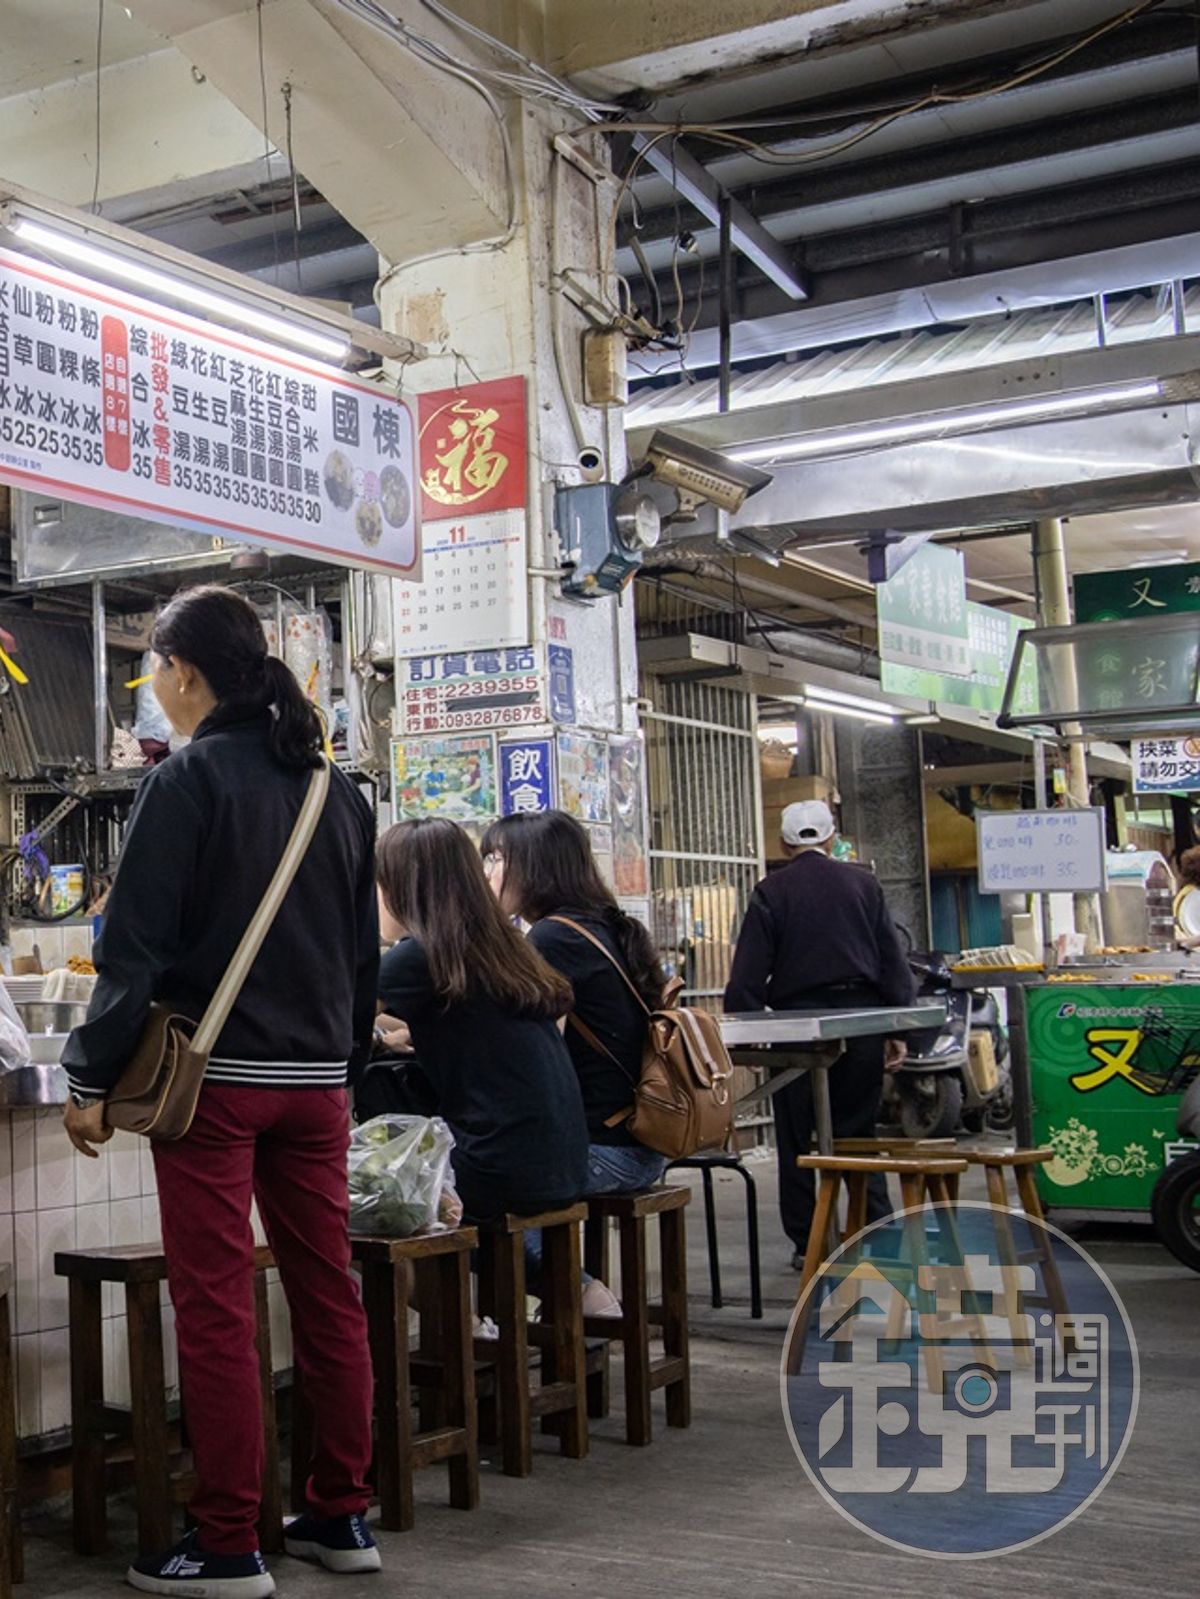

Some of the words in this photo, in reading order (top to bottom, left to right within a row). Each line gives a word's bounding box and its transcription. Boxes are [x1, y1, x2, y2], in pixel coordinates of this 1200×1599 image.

[449, 526, 466, 544] 11
[1140, 760, 1200, 777] 請勿交
[509, 748, 547, 815] 飲食
